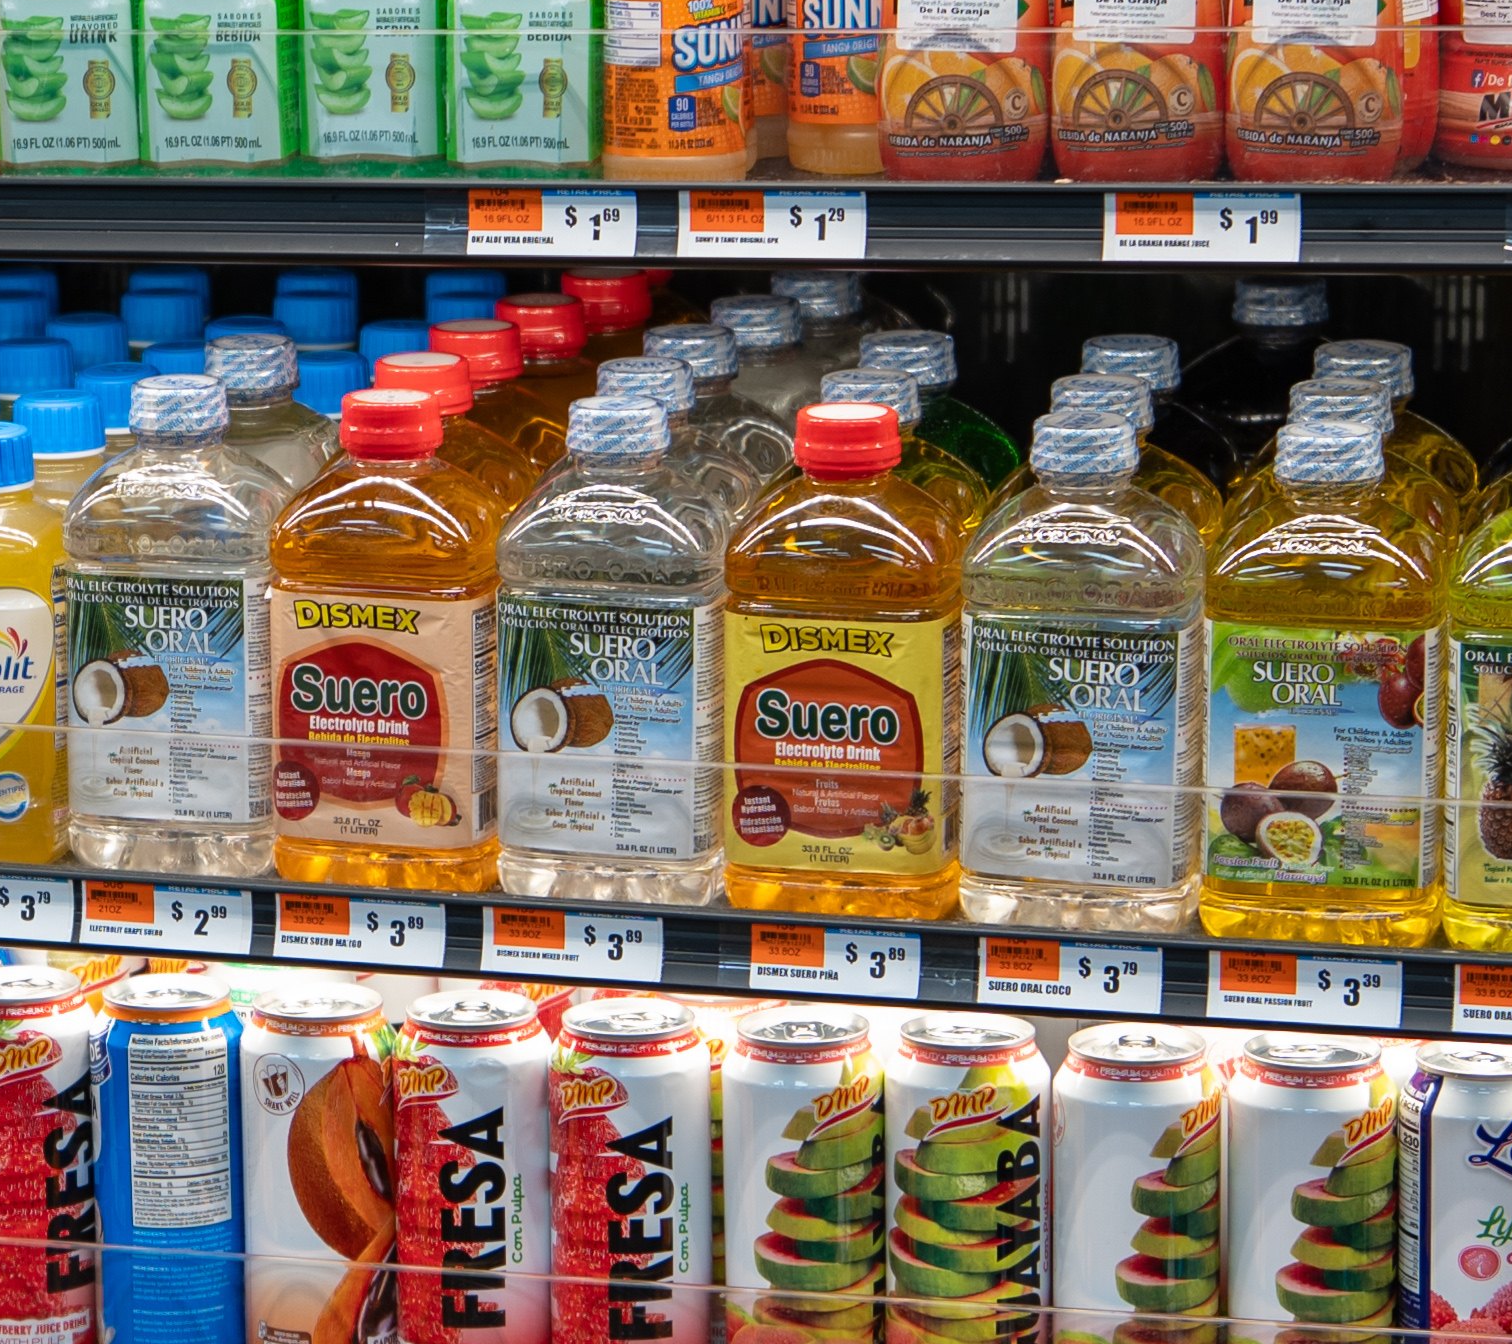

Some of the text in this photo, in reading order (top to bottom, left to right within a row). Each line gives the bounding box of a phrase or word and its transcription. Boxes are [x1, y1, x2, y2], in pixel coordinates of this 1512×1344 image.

[295, 601, 420, 633] DISMEX
[292, 665, 427, 715] Suero
[310, 715, 409, 735] Electrolyte Drink
[607, 1117, 673, 1340] FRESA
[677, 1184, 690, 1274] Con Pulpa
[30, 1318, 58, 1333] JUICE
[62, 1315, 88, 1331] DRINK
